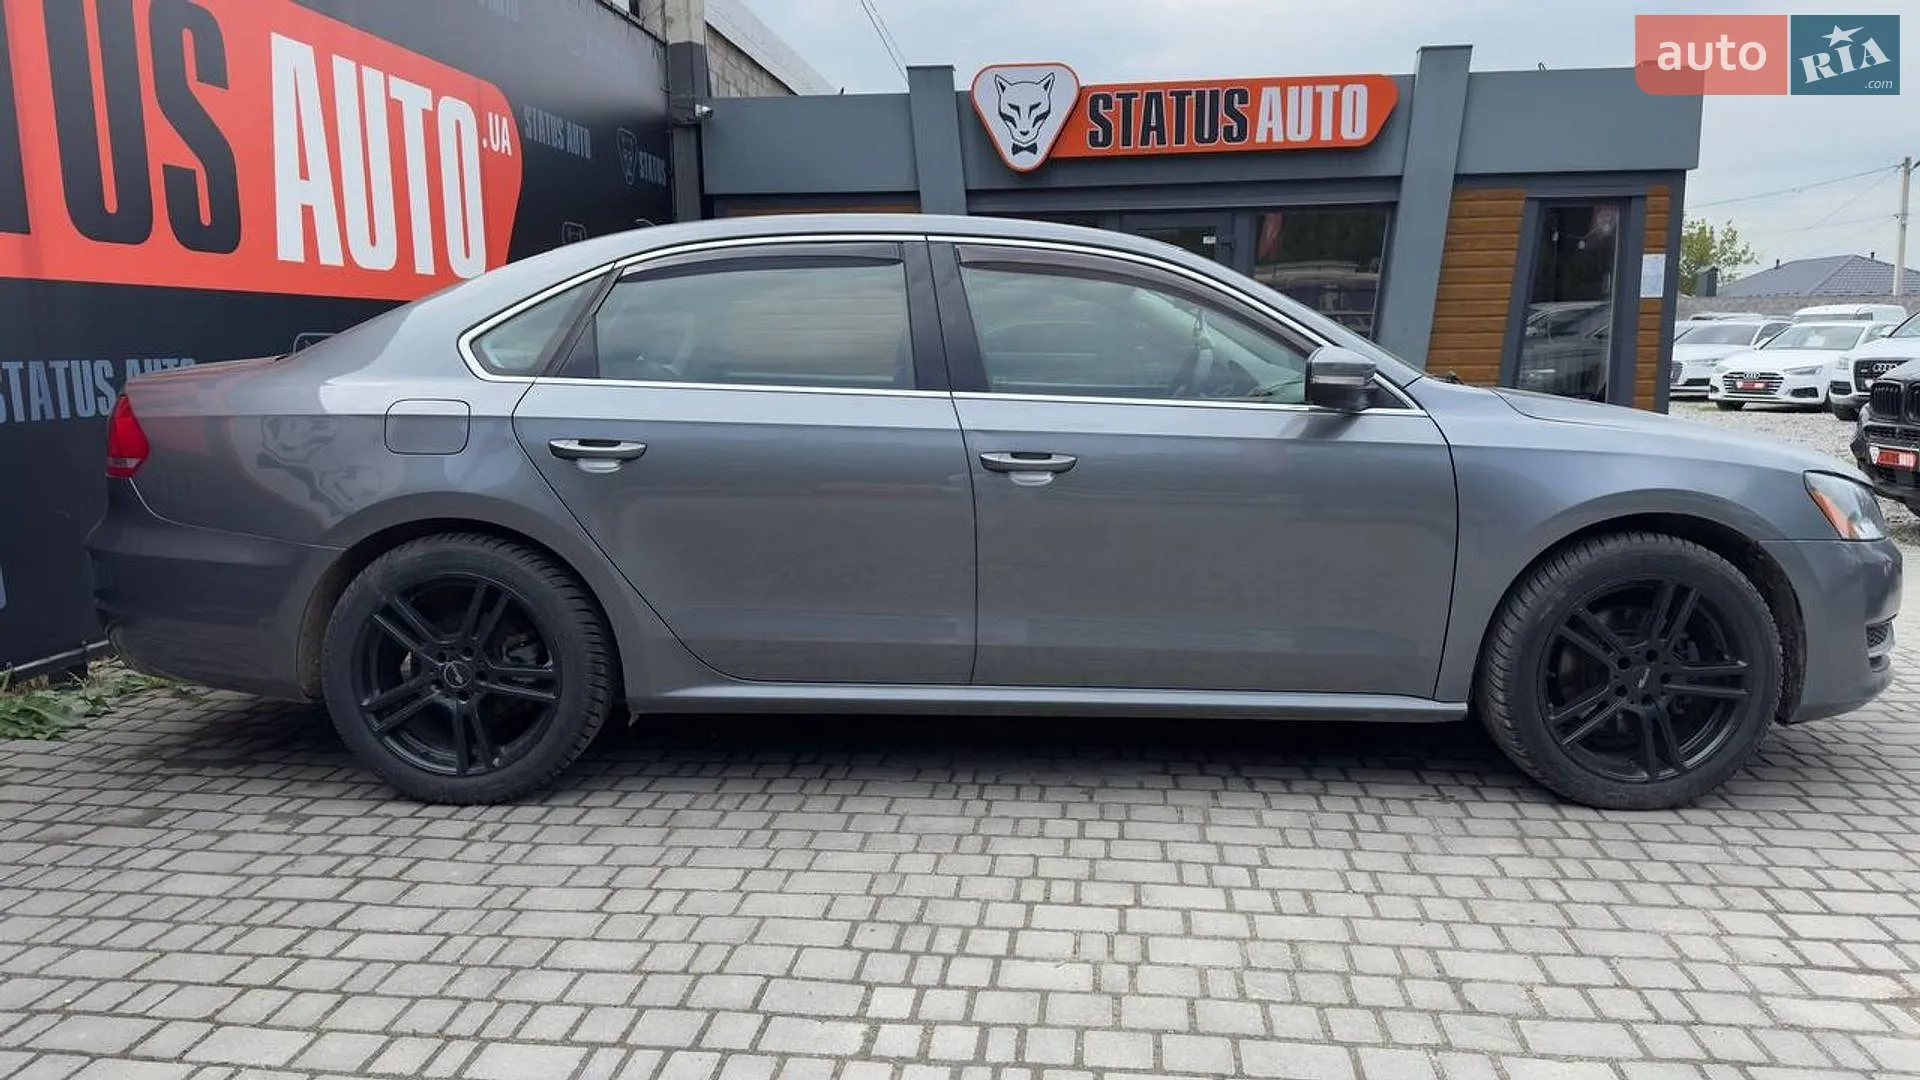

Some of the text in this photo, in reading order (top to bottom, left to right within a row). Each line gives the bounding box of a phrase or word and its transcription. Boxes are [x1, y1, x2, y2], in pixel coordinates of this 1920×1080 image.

[523, 104, 591, 160] STATUS AUTO
[1087, 84, 1368, 150] STATUS AUTO
[271, 32, 486, 279] AUTO
[483, 112, 512, 156] .UA
